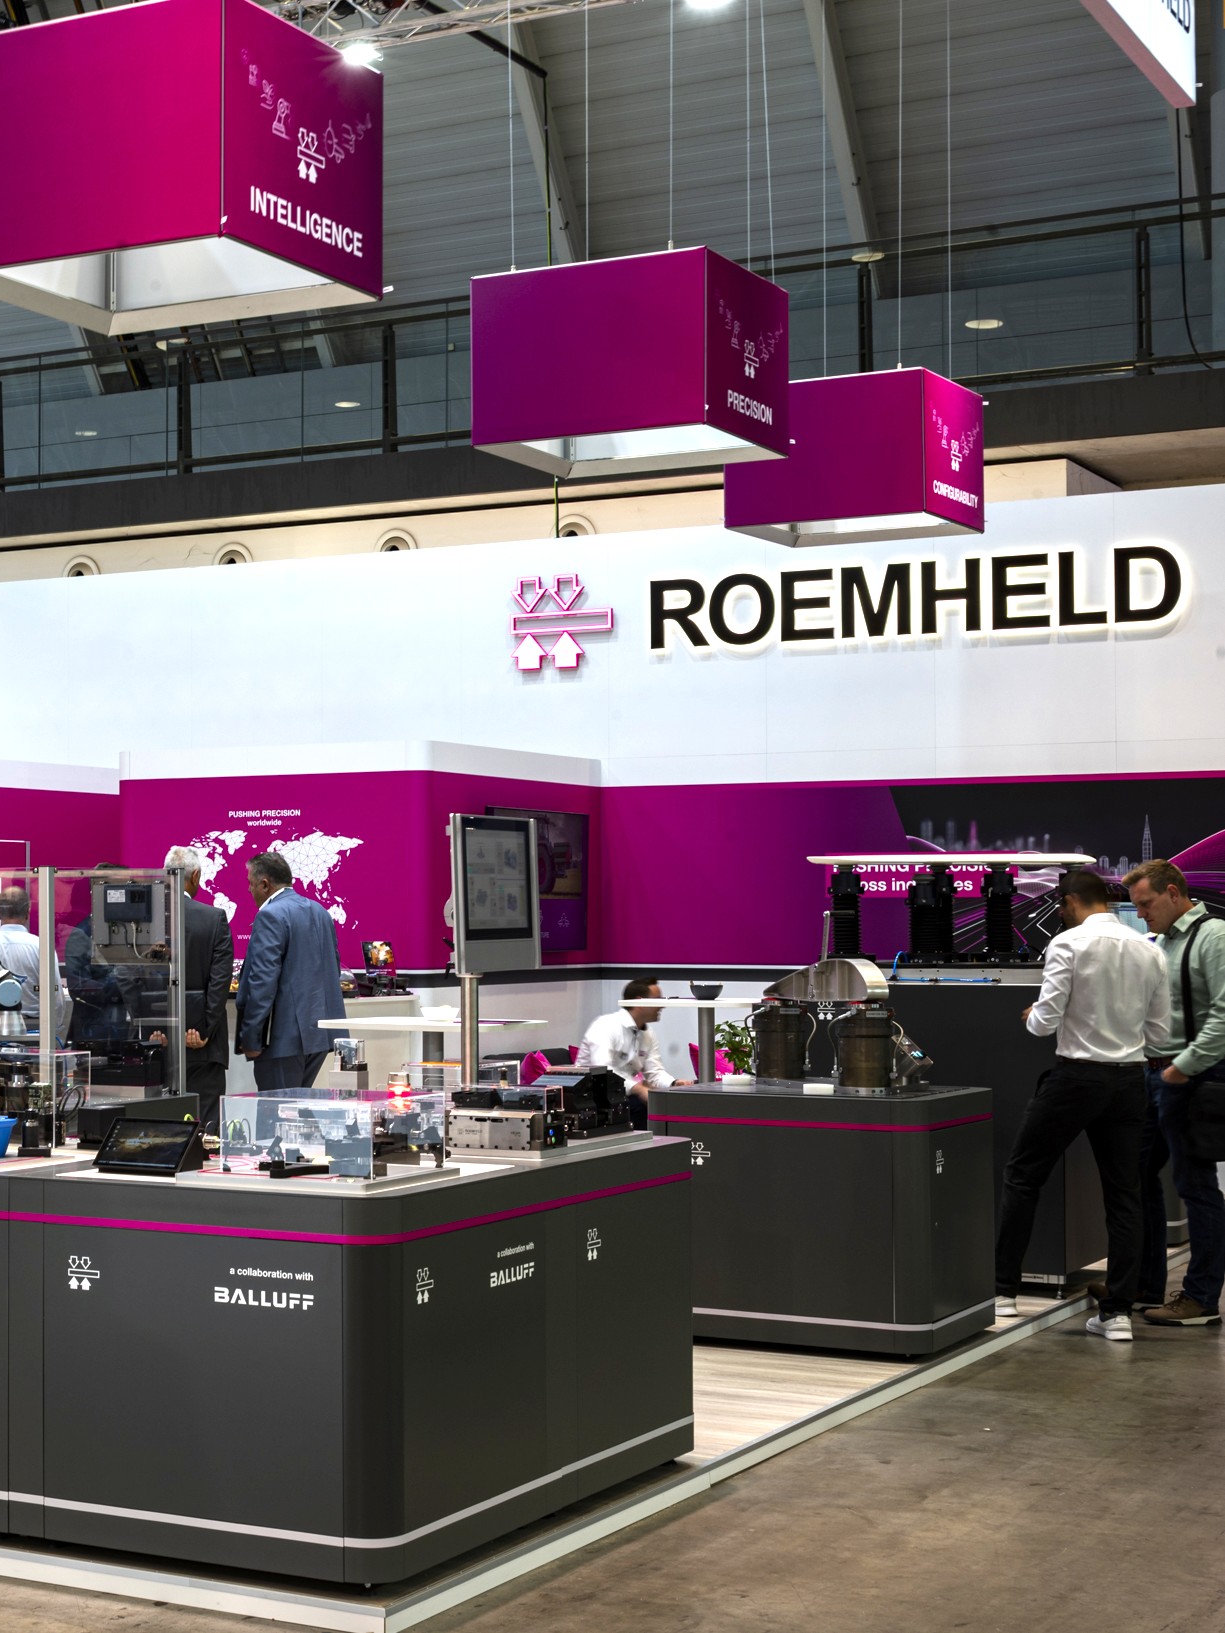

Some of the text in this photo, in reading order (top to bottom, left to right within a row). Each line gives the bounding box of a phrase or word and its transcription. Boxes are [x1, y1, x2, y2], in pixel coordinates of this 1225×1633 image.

[250, 185, 363, 257] INTELLIGENCE
[727, 389, 772, 425] PRECISION
[933, 479, 978, 509] CONFIGURABILITY
[649, 545, 1182, 650] ROEMHELD
[228, 809, 301, 818] PUSHING PRECISION
[501, 1245, 525, 1257] collaboration
[526, 1242, 534, 1250] with
[237, 1267, 293, 1280] collaboration
[295, 1272, 314, 1281] with
[490, 1261, 535, 1288] BALLUFF
[214, 1286, 314, 1310] BALLUFF
